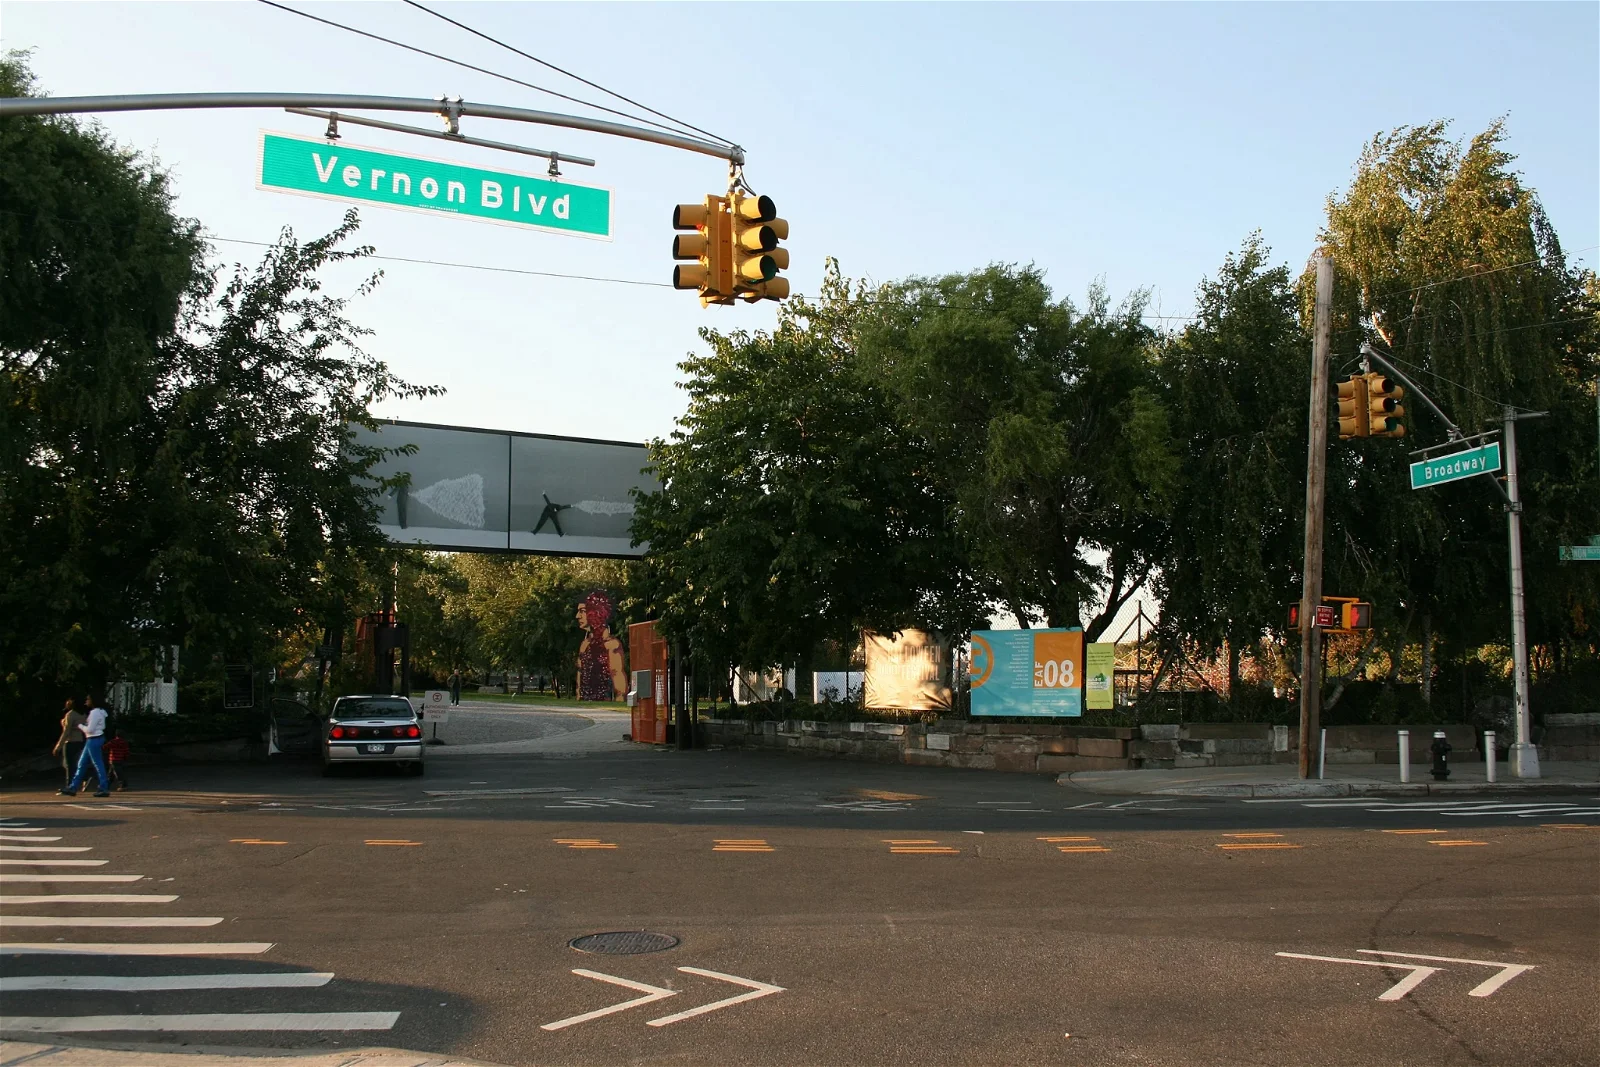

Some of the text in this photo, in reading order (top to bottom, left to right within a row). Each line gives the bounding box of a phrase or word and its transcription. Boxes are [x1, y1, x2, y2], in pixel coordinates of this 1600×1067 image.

[311, 152, 571, 220] Vernon Blvd
[1424, 456, 1486, 480] Broadway
[1034, 661, 1044, 687] EAF
[1043, 659, 1075, 688] 08
